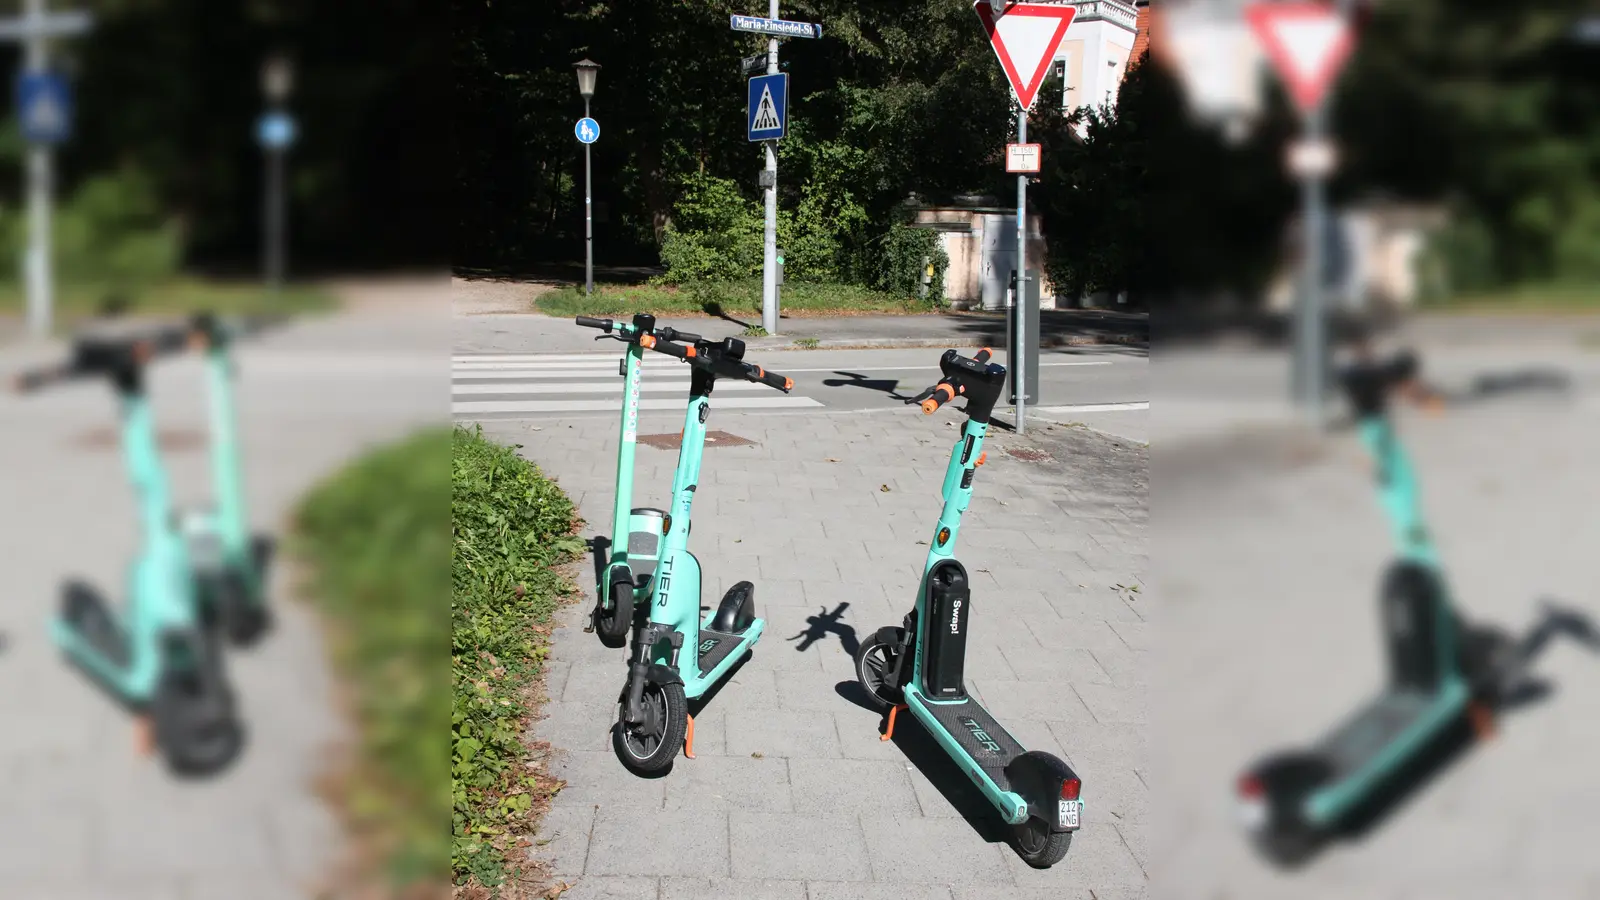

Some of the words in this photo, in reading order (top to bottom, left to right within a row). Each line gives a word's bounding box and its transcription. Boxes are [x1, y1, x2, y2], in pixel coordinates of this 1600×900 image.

[657, 555, 674, 608] TIER
[950, 600, 962, 634] Swap!
[964, 719, 1000, 753] TIER
[1060, 801, 1076, 813] 212
[1060, 815, 1077, 826] WNG
